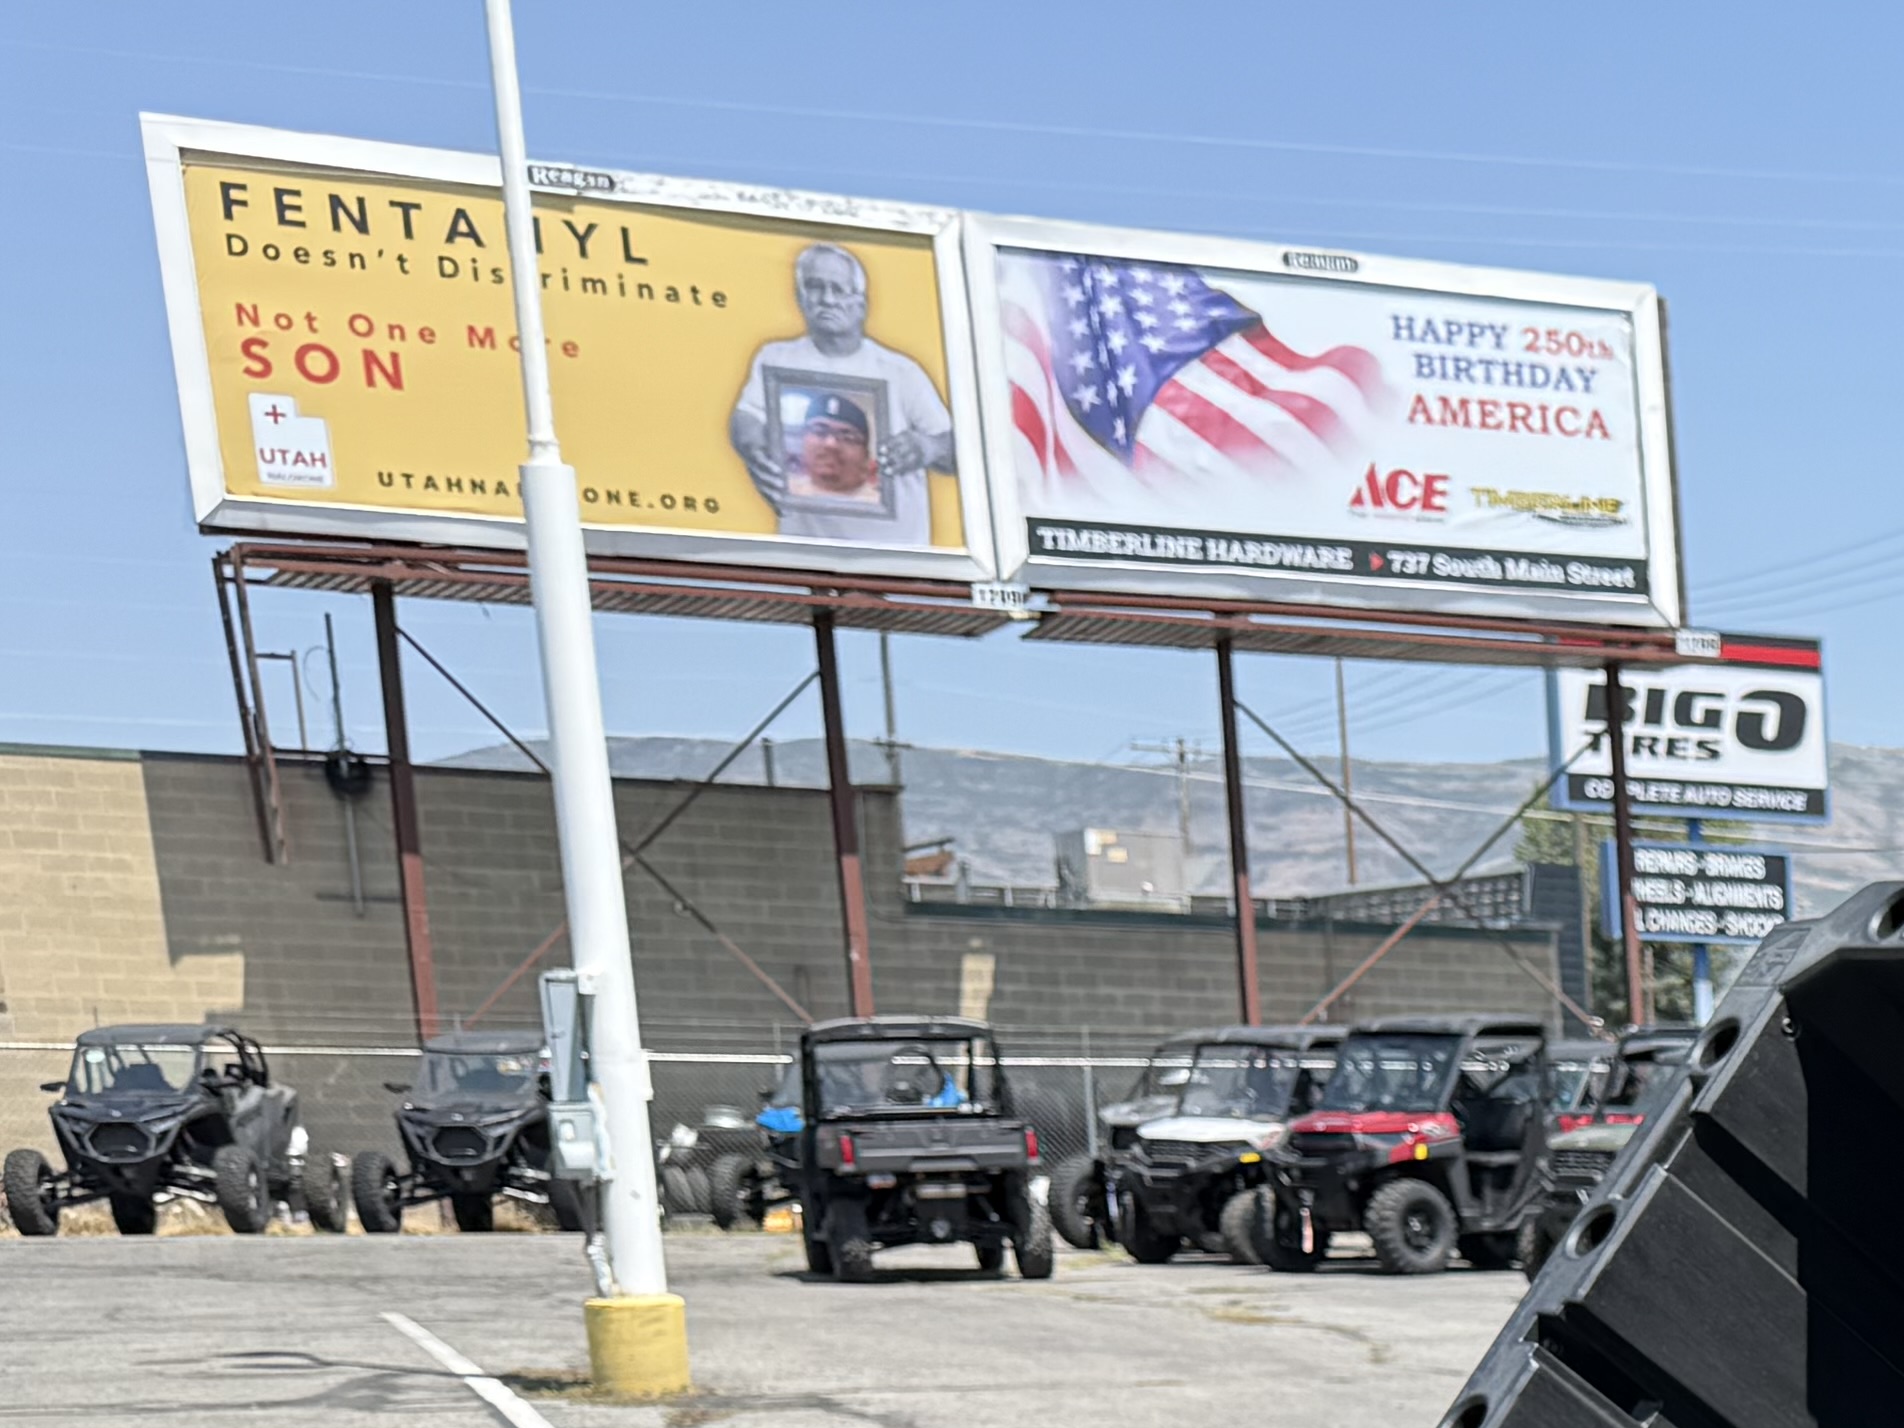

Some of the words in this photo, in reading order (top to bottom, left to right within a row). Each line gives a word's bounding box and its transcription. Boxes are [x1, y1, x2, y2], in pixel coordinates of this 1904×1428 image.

[225, 233, 410, 275] Doesn't
[438, 255, 728, 309] Disriminate
[235, 302, 319, 334] Not
[348, 312, 436, 344] One
[1391, 313, 1509, 350] HAPPY
[1520, 326, 1615, 361] 250th
[241, 336, 405, 392] SON
[1413, 352, 1598, 393] BIRTHDAY
[1407, 393, 1612, 440] AMERICA
[259, 447, 327, 469] UTAH
[1350, 462, 1450, 513] ACE
[1036, 526, 1204, 561] TIMBERLINE
[1206, 538, 1354, 571] HARDWARE
[1387, 550, 1431, 575] 737
[1432, 553, 1503, 580] South
[1504, 557, 1566, 584] Main
[1566, 561, 1636, 588] Street
[1583, 726, 1722, 760] TRES
[1584, 777, 1682, 804] COPLETE
[1683, 783, 1732, 808] AUTO
[1731, 787, 1808, 812] SERVICE
